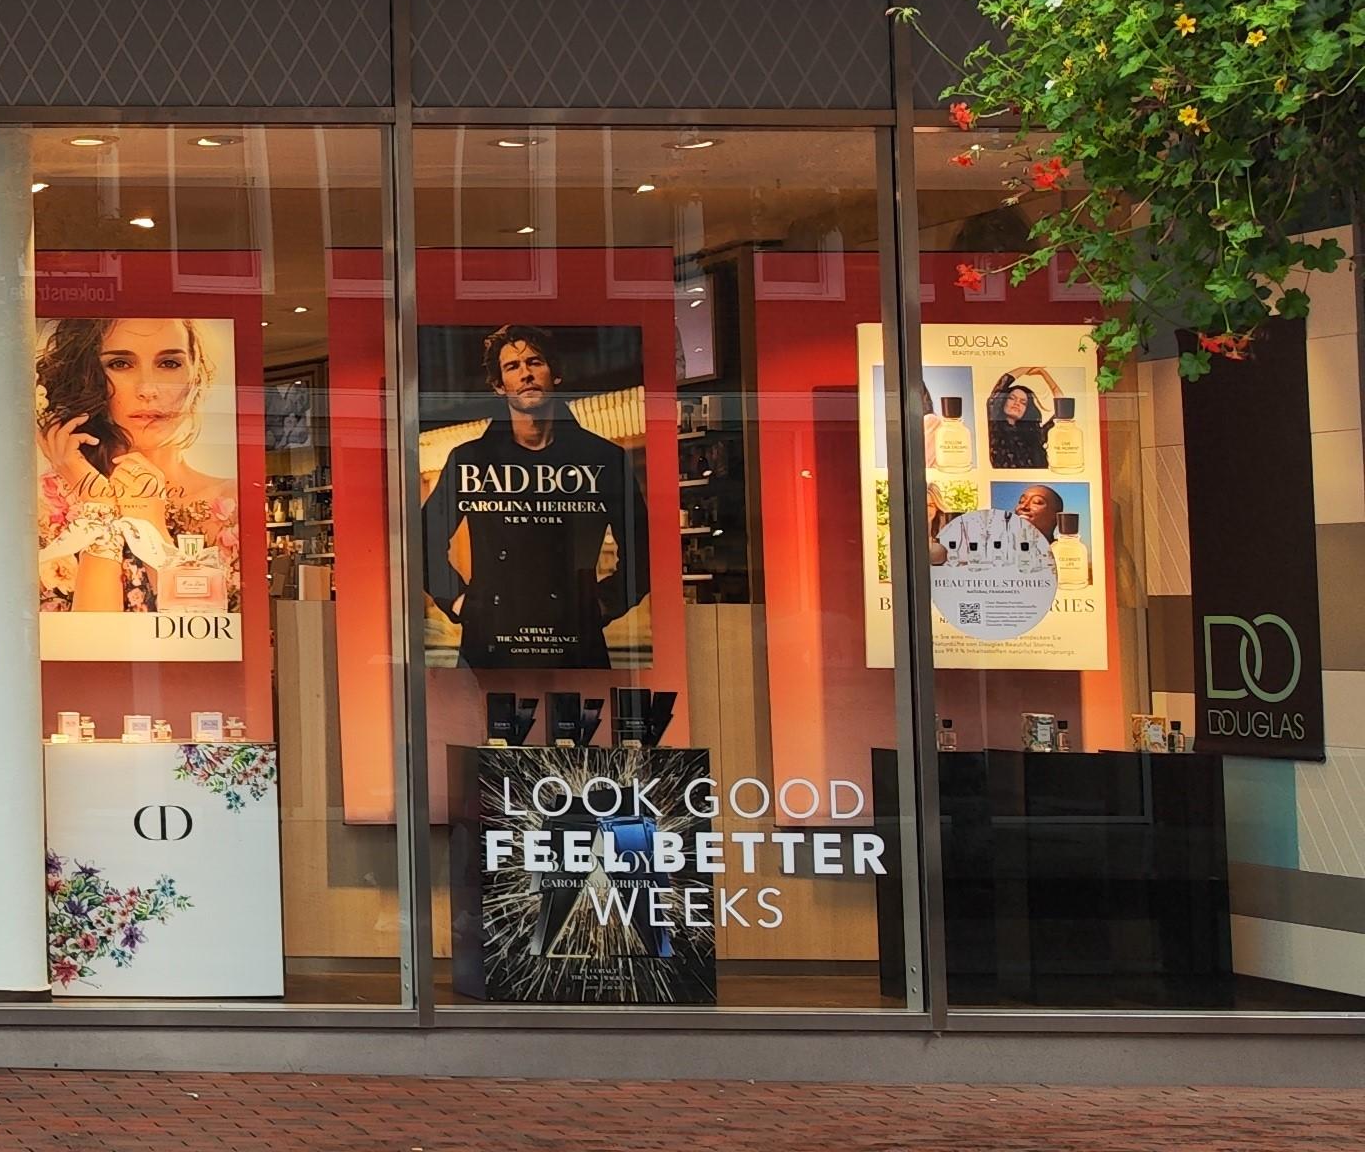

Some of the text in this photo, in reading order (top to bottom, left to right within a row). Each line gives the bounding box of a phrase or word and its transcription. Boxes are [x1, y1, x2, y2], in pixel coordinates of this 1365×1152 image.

[947, 335, 1009, 348] DOUGLAS
[64, 471, 187, 499] Miss Dior
[457, 463, 606, 494] BAD BOY
[458, 500, 607, 513] CAROLINA HERRERA
[533, 516, 563, 524] YORK
[934, 579, 1051, 587] BEAUTIFUL STORIES
[1050, 598, 1095, 613] RIES
[153, 615, 234, 640] DIOR
[1207, 709, 1305, 740] DOUGLAS
[502, 775, 866, 820] LOOK GOOD
[485, 830, 889, 875] FEEL BETTER
[541, 879, 600, 888] CAROLINA
[587, 886, 785, 930] WEEKS
